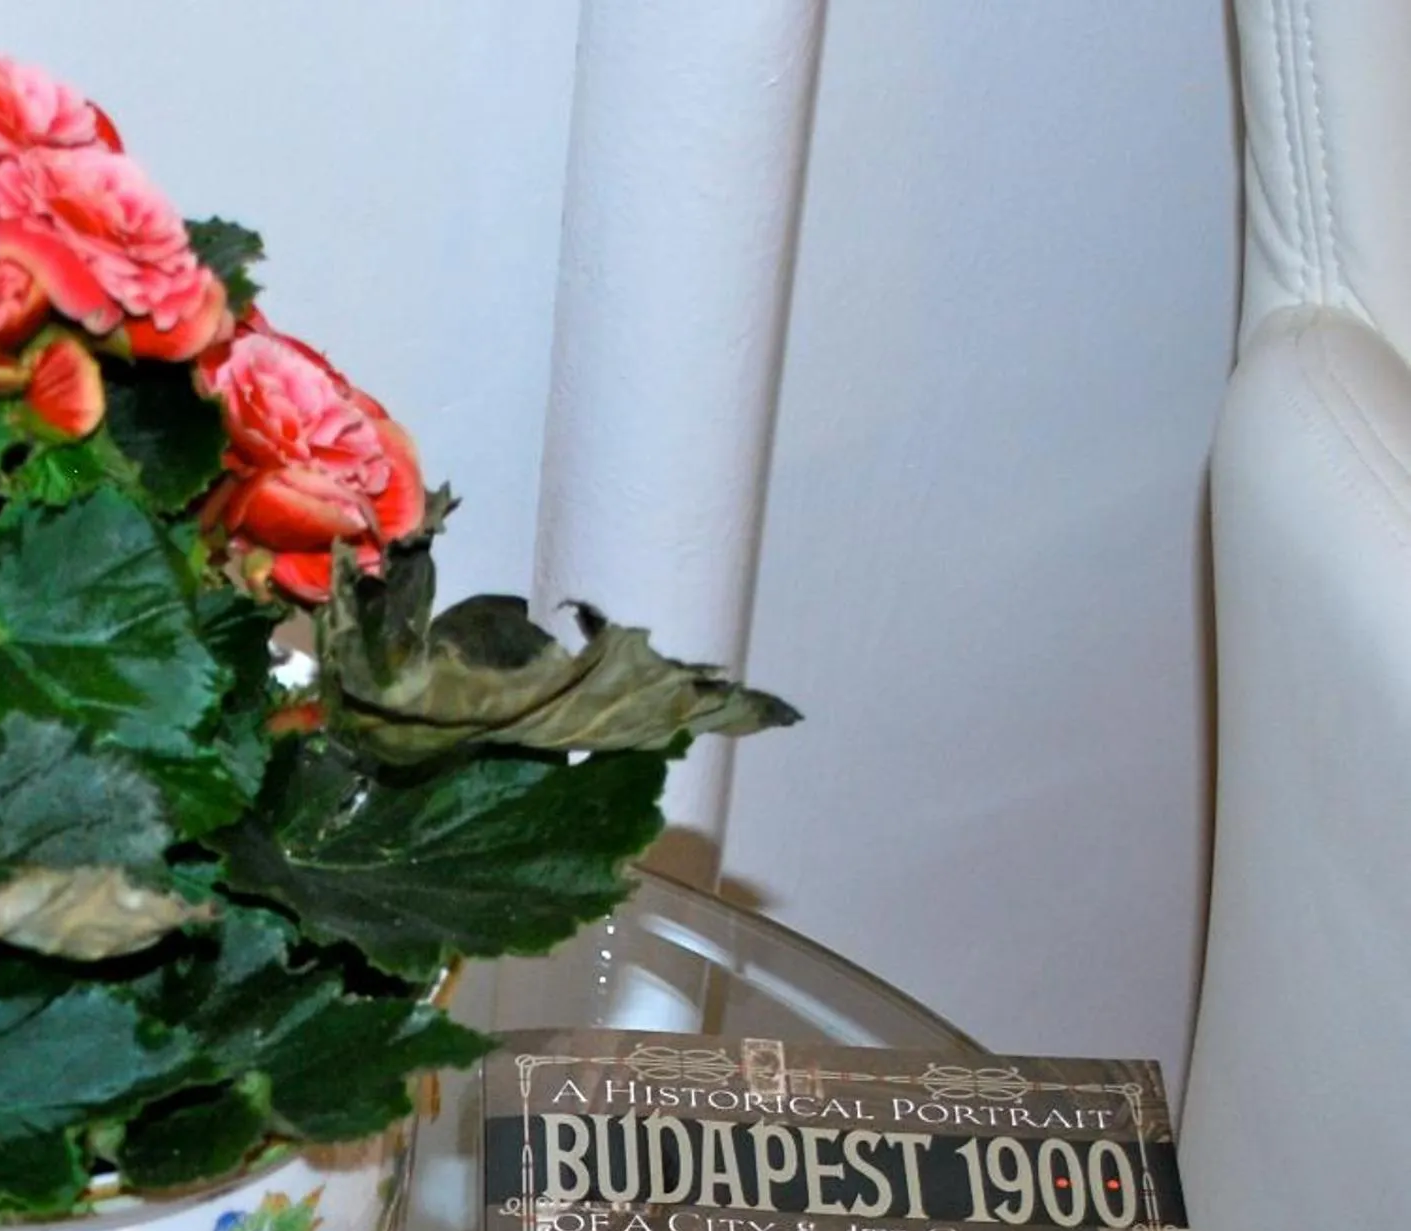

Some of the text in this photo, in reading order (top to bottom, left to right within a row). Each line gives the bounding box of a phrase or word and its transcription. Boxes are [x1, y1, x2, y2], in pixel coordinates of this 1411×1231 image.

[553, 1080, 1114, 1130] A HISTORICAL PORTRAIT
[541, 1107, 1137, 1228] BUDAPEST 1900
